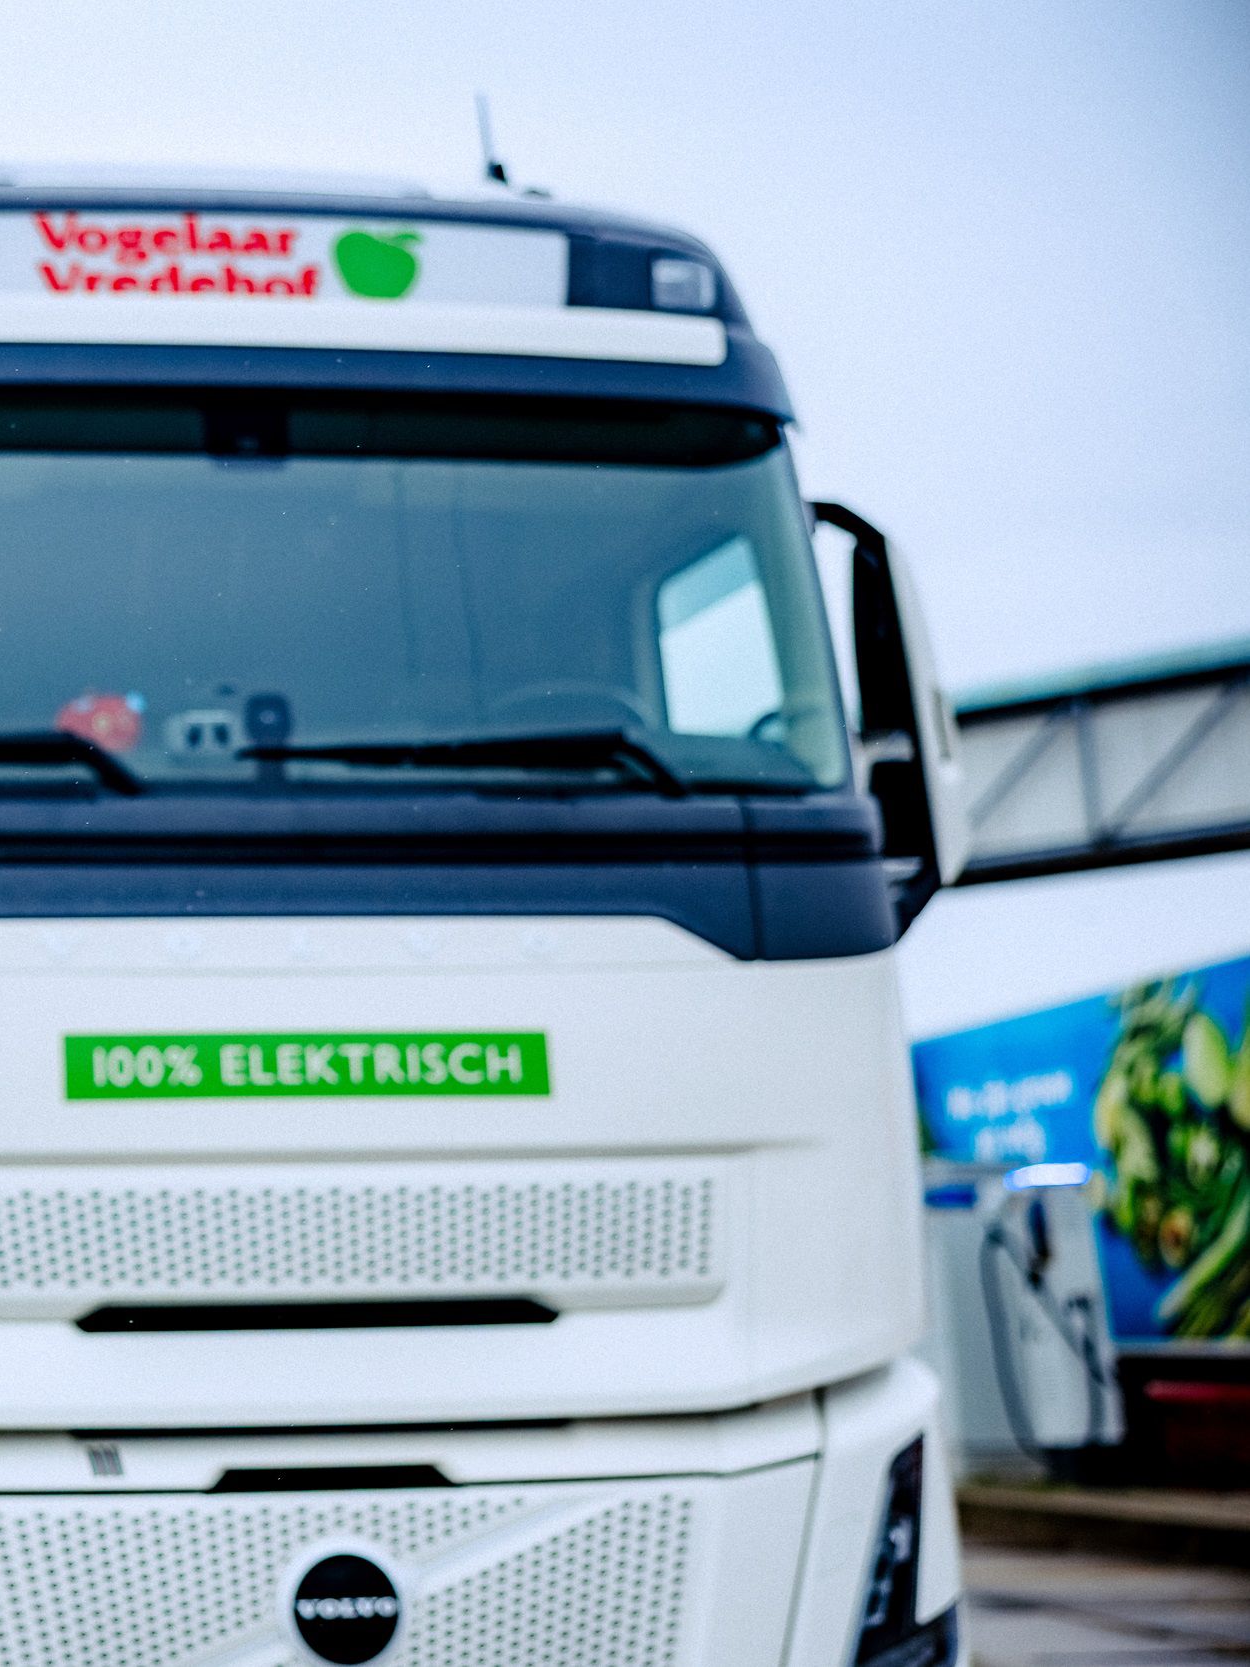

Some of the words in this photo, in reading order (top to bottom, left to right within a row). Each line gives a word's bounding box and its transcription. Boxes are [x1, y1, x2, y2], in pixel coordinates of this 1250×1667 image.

[35, 211, 298, 264] Vogelaar
[39, 264, 318, 297] Vredehof
[92, 1045, 203, 1088] 100%
[219, 1042, 524, 1087] ELEKTRISCH
[297, 1596, 398, 1620] VOLVO
